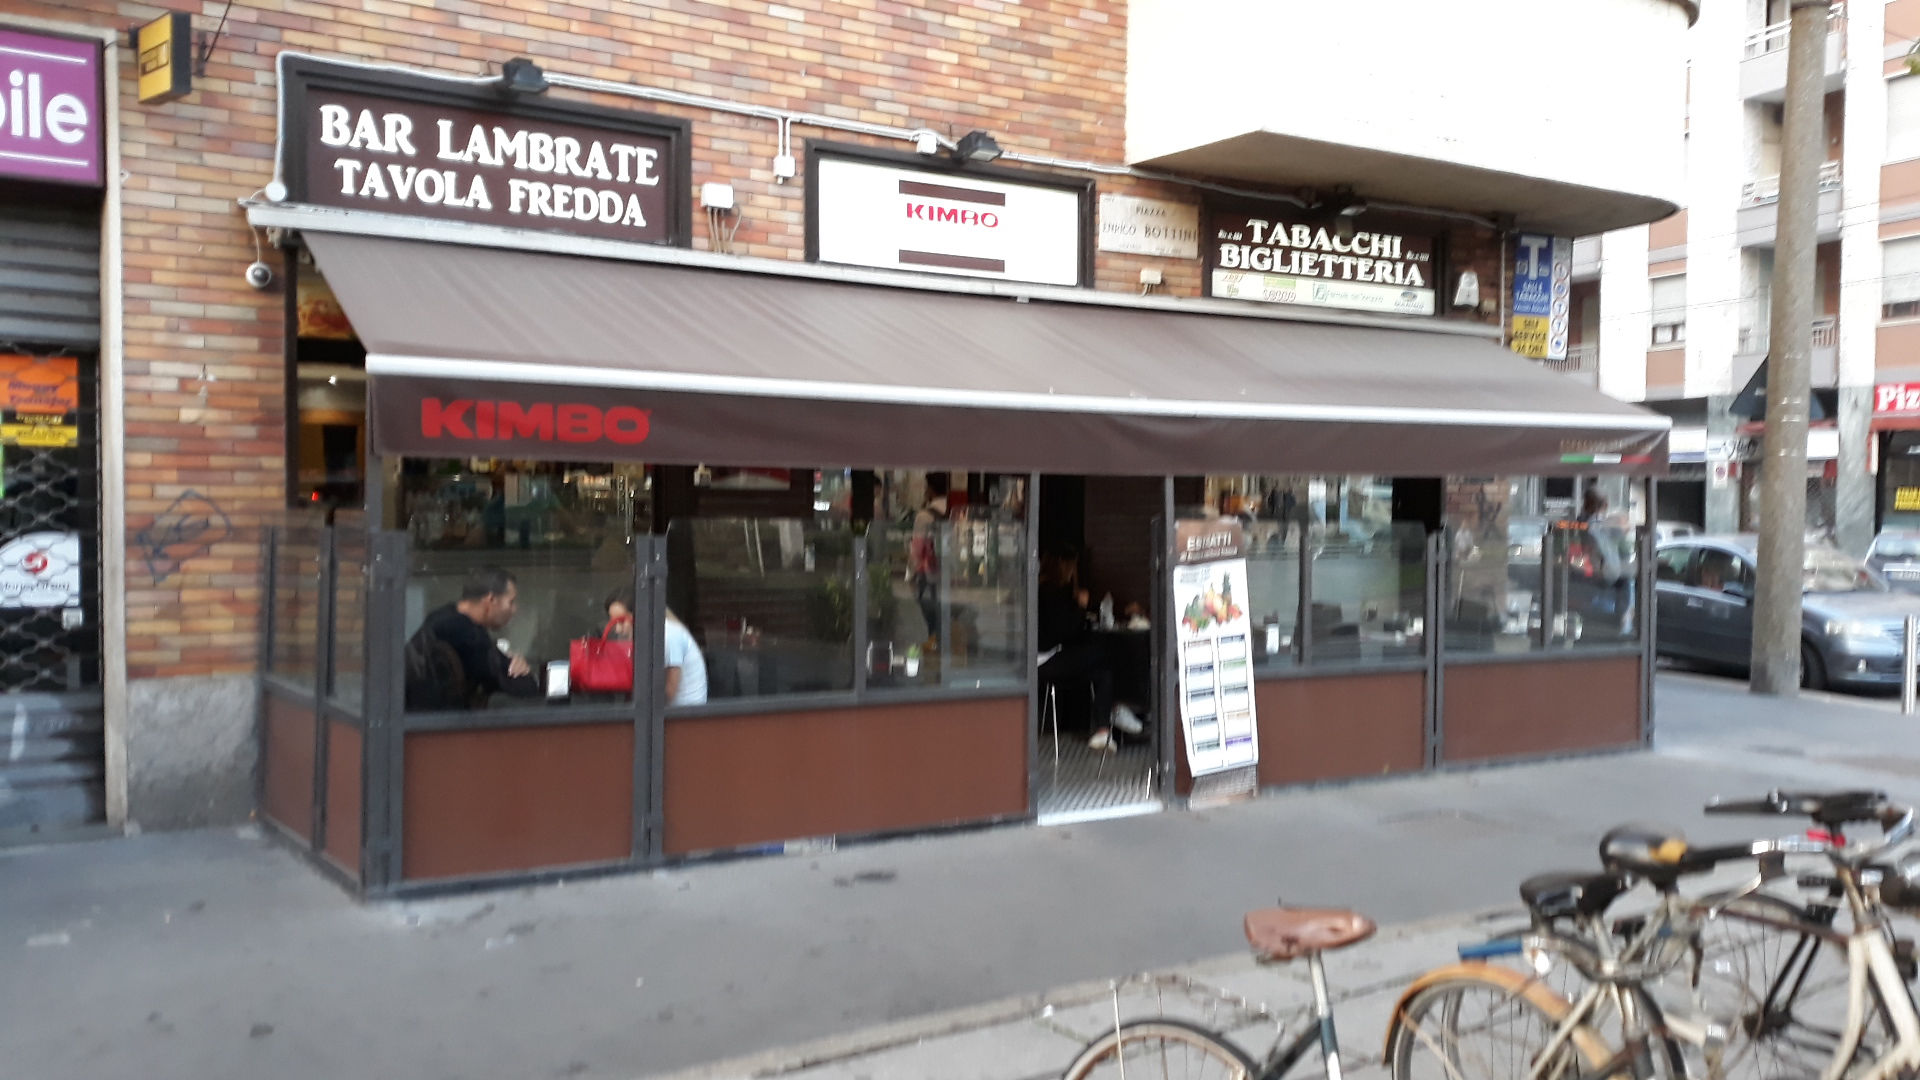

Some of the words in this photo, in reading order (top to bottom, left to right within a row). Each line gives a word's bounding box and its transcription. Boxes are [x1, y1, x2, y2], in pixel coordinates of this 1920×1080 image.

[0, 70, 87, 144] ile
[319, 104, 415, 155] BAR
[436, 118, 660, 187] LAMBRATE
[334, 158, 493, 210] TAVOLA
[507, 179, 647, 228] FREDDA
[906, 202, 999, 228] KIMBO
[1246, 218, 1403, 259] TABACCHI
[1520, 235, 1549, 280] T
[1218, 243, 1425, 287] BIGLIETTERIA
[421, 397, 651, 444] KIMBO
